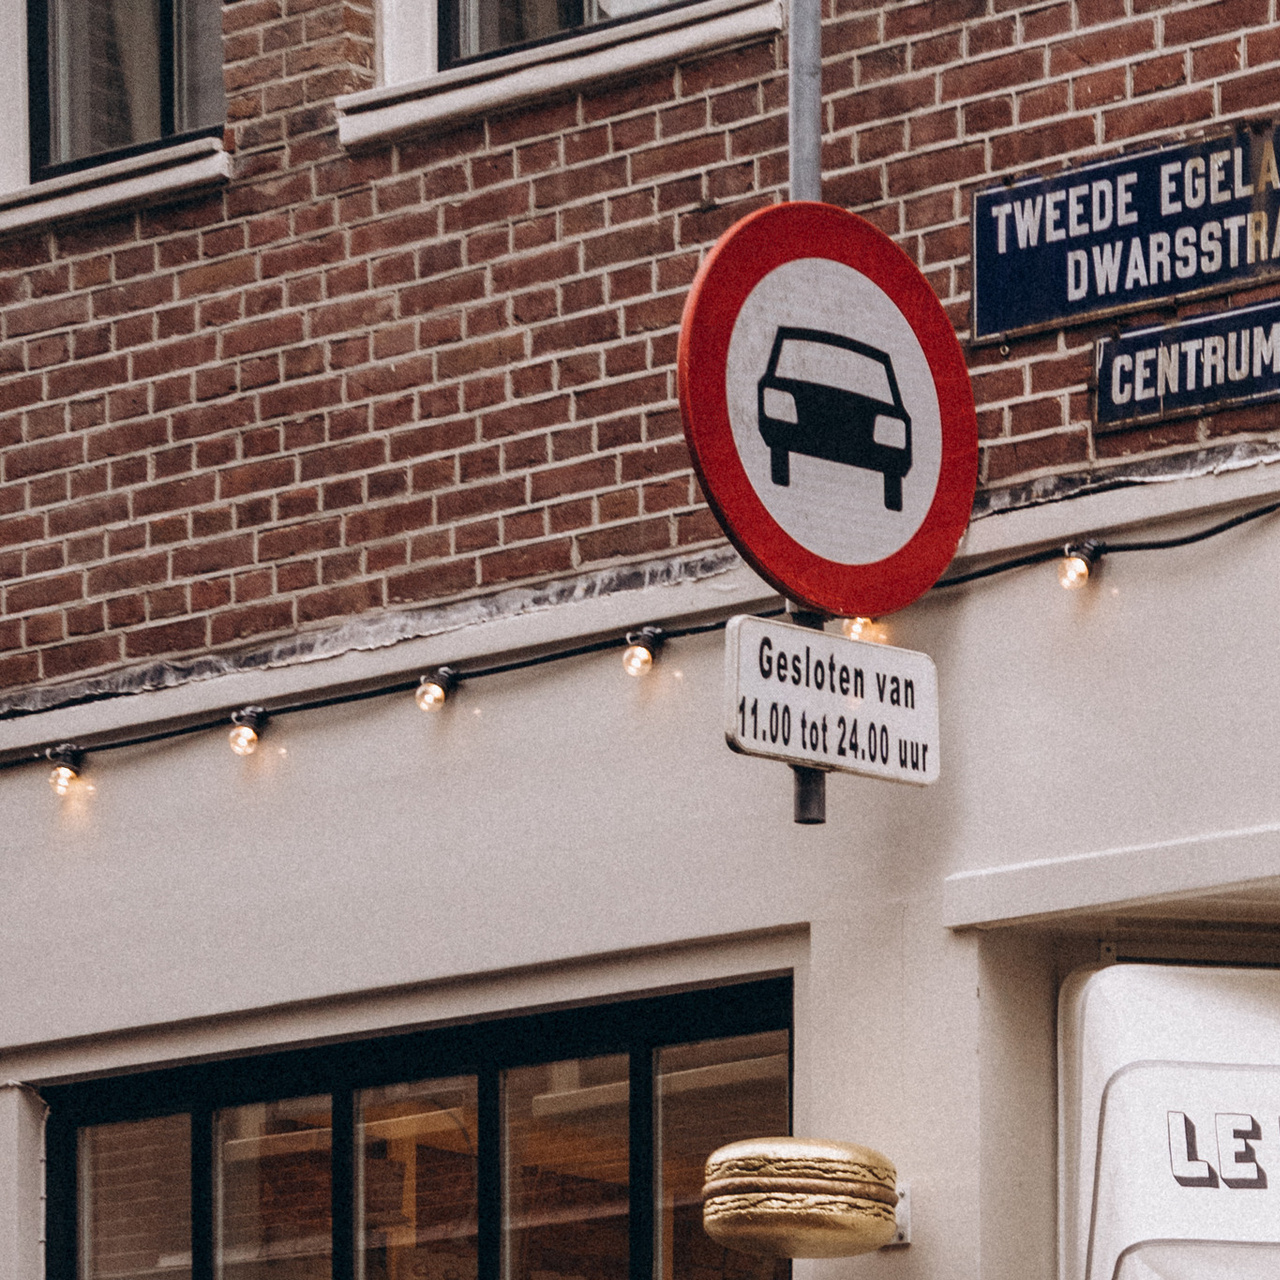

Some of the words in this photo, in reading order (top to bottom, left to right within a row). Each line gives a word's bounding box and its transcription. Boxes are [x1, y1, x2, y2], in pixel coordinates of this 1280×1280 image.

[991, 172, 1139, 254] TWEEDE
[758, 636, 864, 699] Gesloten
[876, 672, 915, 709] van
[738, 695, 791, 746] 11.00
[801, 711, 828, 754] tot
[837, 715, 889, 765] 24.00
[899, 738, 928, 772] uur
[1167, 1110, 1267, 1189] LE
